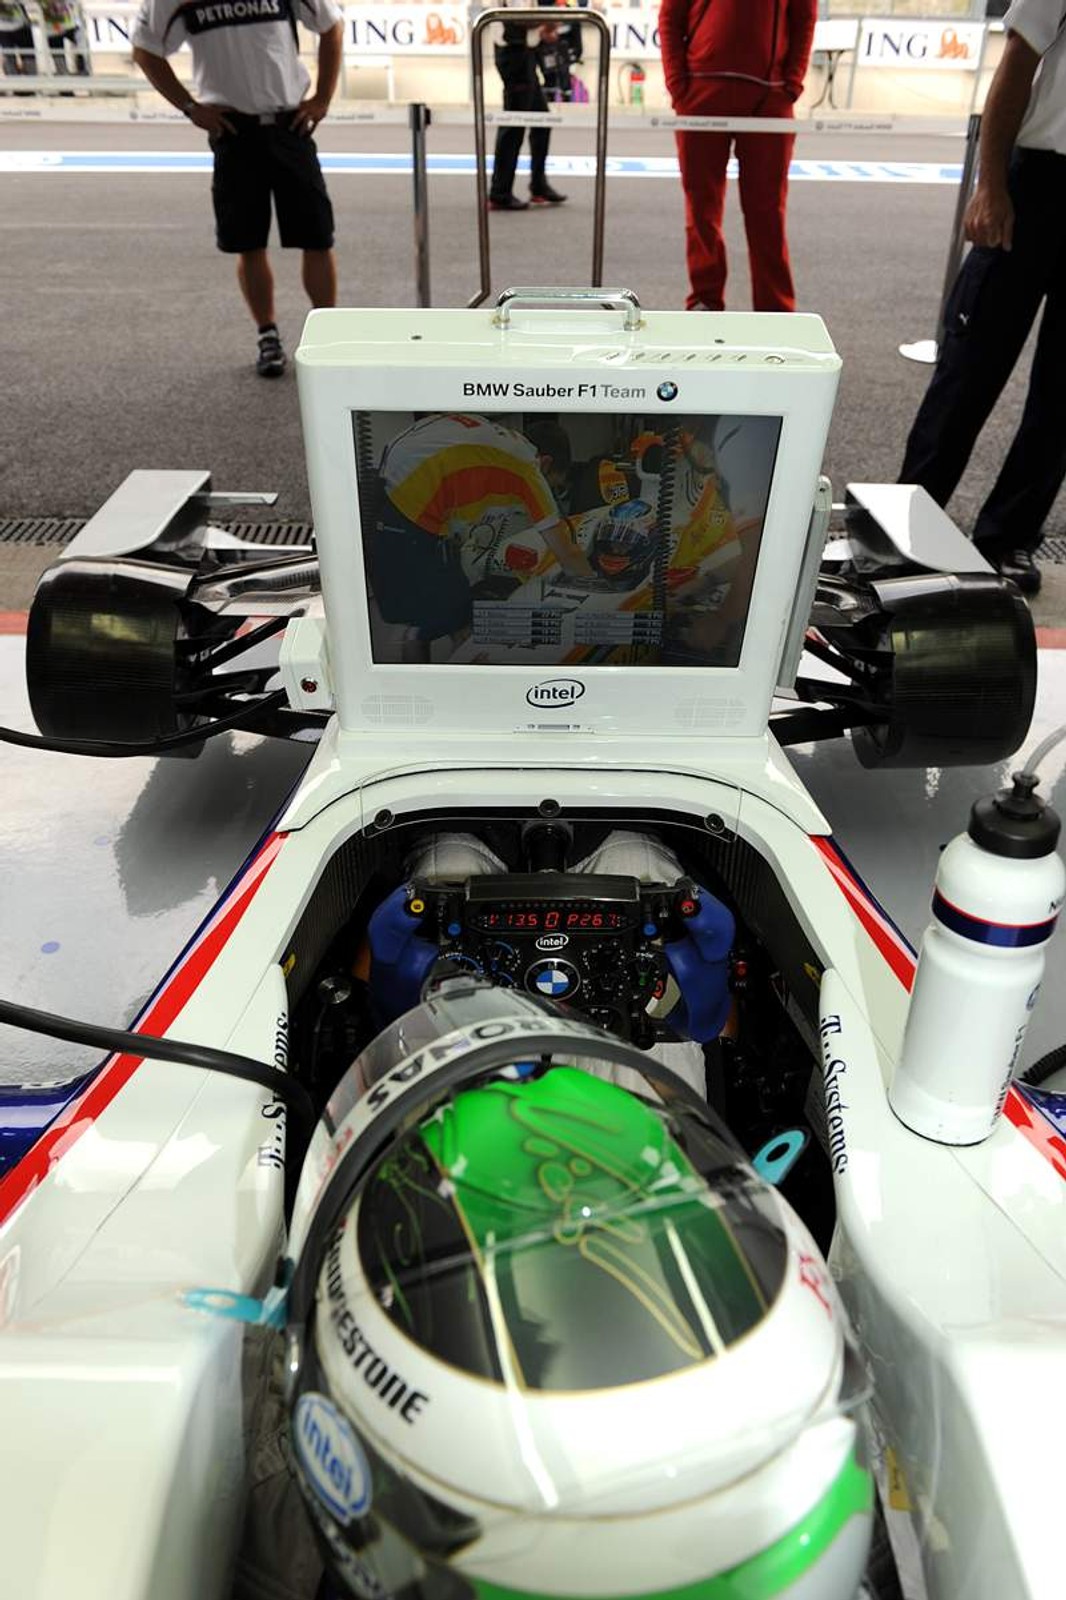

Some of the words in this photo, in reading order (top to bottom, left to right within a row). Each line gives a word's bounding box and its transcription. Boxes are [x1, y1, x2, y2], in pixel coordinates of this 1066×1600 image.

[195, 0, 281, 24] PETRONAS
[93, 17, 131, 42] IN
[351, 19, 414, 45] ING
[865, 32, 929, 59] ING
[463, 383, 509, 397] BMW
[513, 383, 574, 397] Sauber
[578, 384, 597, 397] F1
[600, 384, 646, 398] Team
[534, 685, 575, 699] intel
